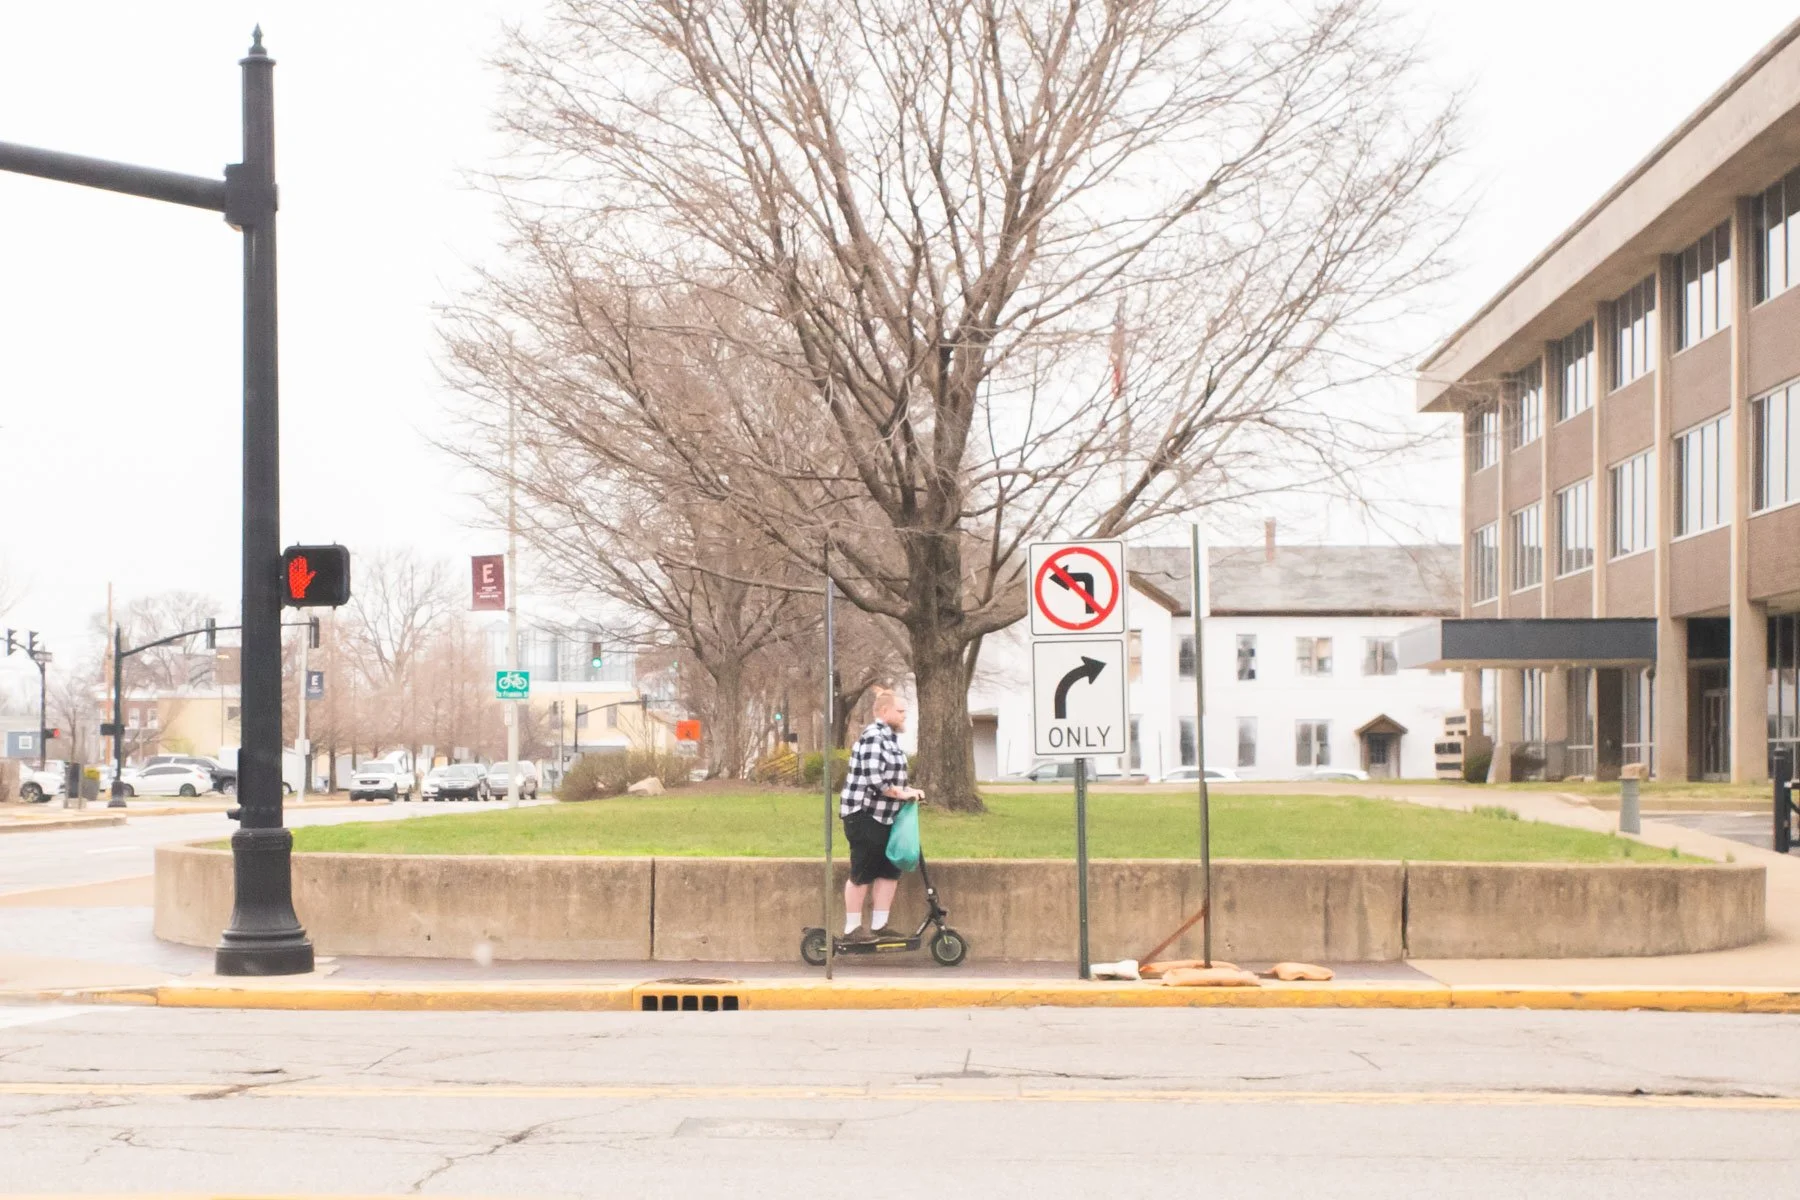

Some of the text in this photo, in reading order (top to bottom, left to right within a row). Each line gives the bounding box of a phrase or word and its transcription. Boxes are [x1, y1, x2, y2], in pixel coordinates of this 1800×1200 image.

[482, 563, 495, 584] E
[311, 675, 319, 686] E
[1048, 726, 1111, 748] ONLY
